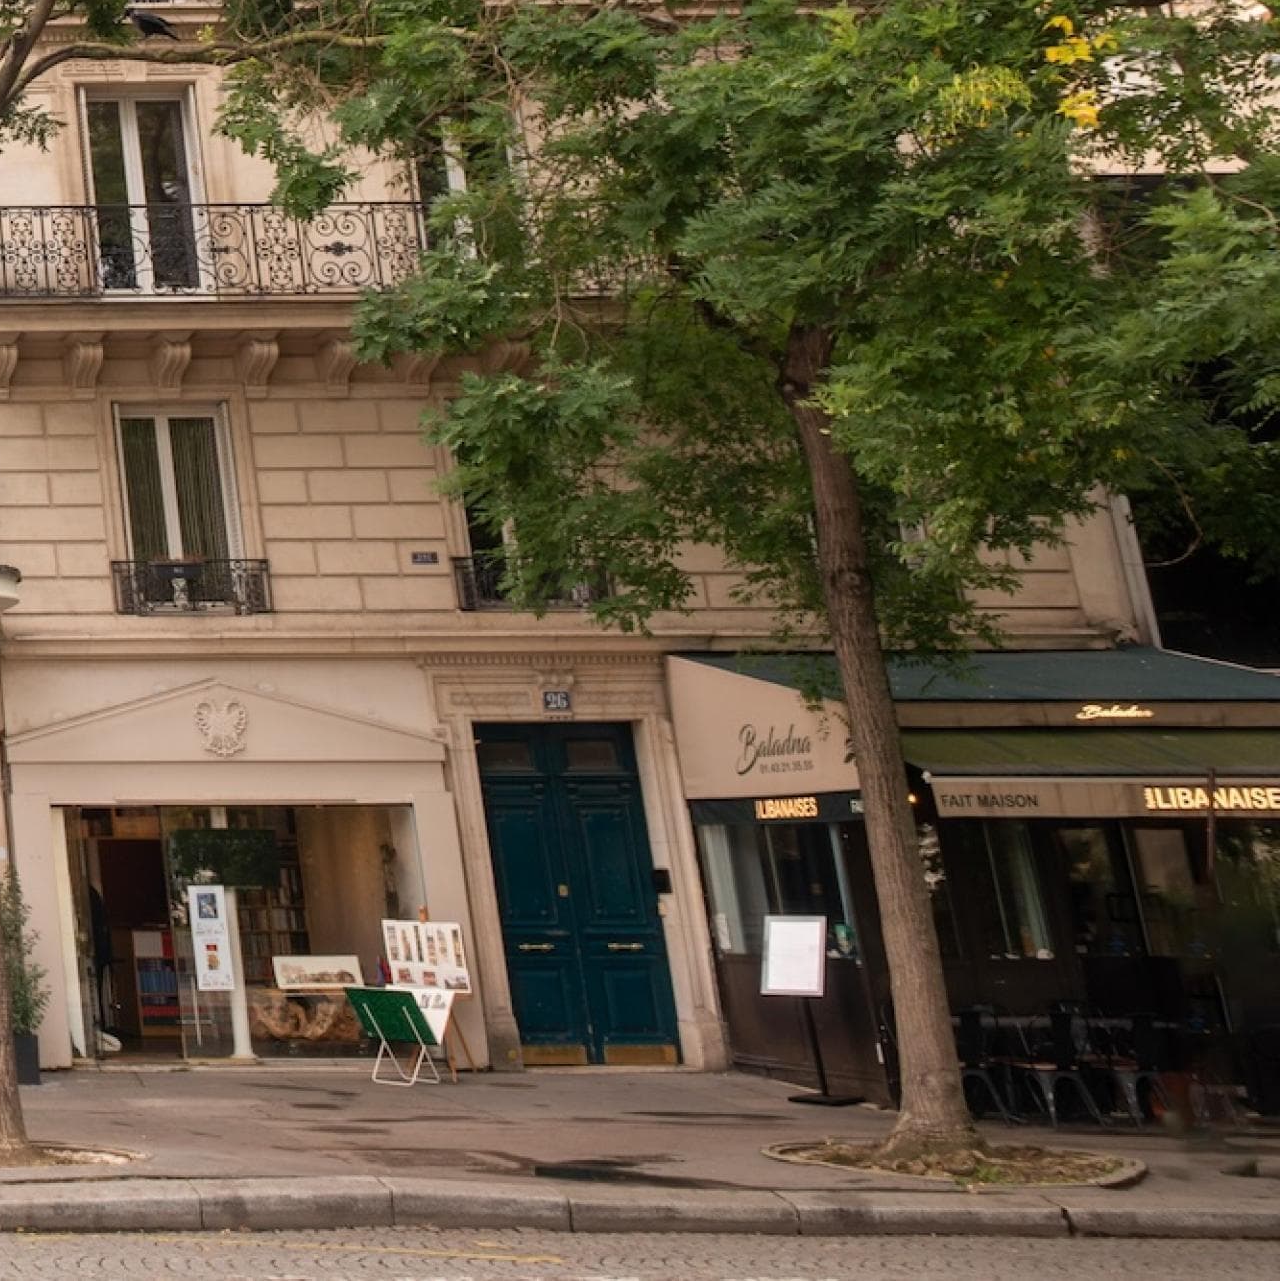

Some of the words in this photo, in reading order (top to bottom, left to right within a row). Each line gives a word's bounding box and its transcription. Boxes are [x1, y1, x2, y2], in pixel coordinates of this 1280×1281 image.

[736, 723, 811, 776] Baladna
[941, 794, 973, 807] FAIT
[977, 794, 1038, 808] MAISON
